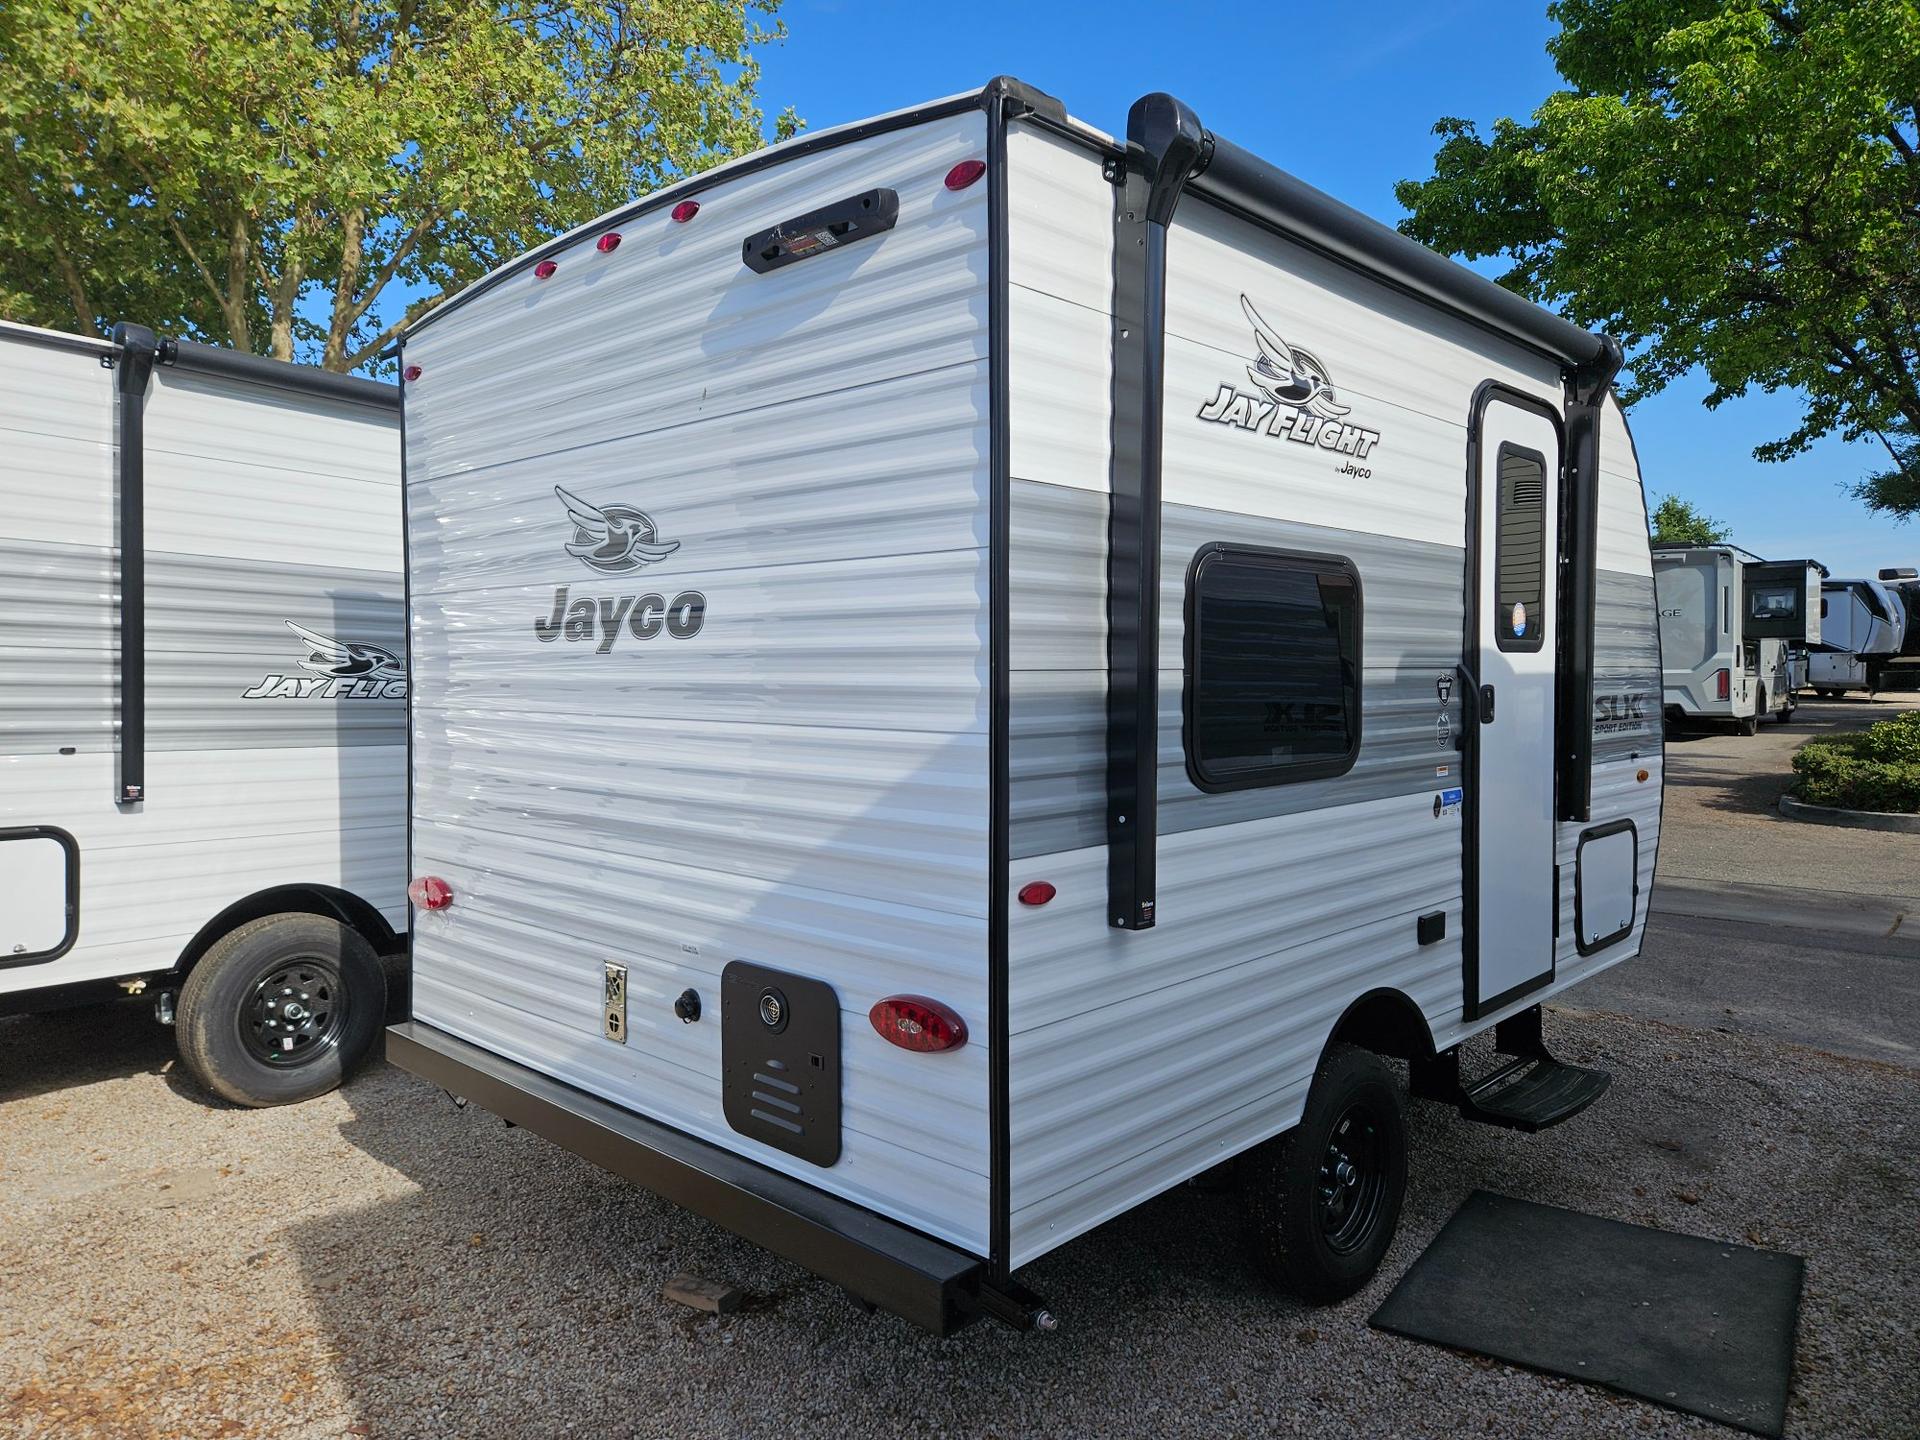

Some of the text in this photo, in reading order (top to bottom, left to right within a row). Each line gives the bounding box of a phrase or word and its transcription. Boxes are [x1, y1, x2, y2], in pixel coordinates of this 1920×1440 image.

[1197, 384, 1380, 459] JAY FLIGHT
[1341, 461, 1371, 479] Jayco
[535, 584, 708, 654] Jayco
[1659, 609, 1682, 617] GE
[241, 674, 407, 699] JAY FLIG
